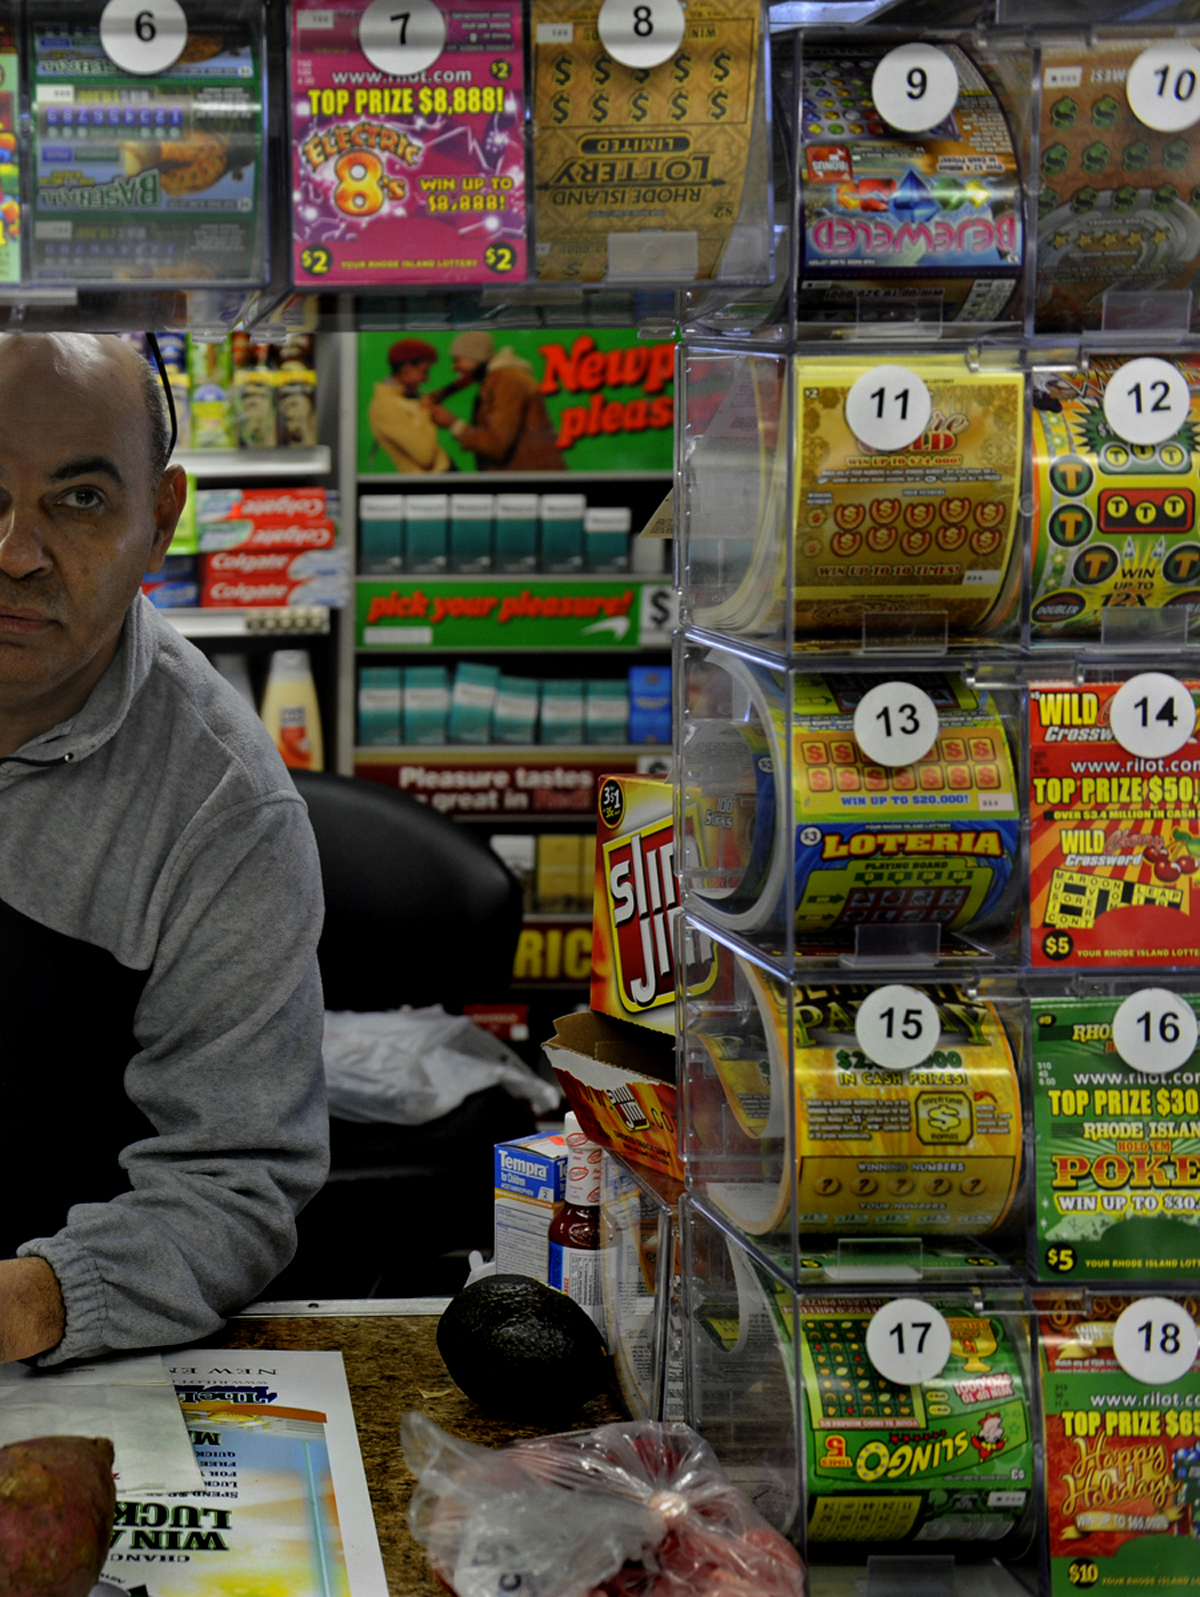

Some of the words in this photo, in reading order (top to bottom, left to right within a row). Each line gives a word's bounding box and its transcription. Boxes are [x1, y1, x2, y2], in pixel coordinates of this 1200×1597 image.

[134, 11, 157, 42] 6
[390, 13, 411, 45] 7
[632, 6, 654, 37] 8
[491, 61, 510, 78] $2
[906, 67, 928, 100] 9
[1153, 64, 1196, 101] 10
[308, 88, 350, 115] TOP
[354, 88, 414, 115] PRIZE
[418, 86, 505, 116] $8,888!
[301, 120, 423, 173] ELECTRIC
[596, 137, 675, 153] LIMITED
[553, 155, 712, 185] LOTTERY
[39, 168, 158, 209] BASEBALL
[420, 177, 456, 191] WIN
[462, 177, 485, 191] UP
[490, 177, 513, 191] TO
[631, 188, 702, 204] RHODE
[429, 194, 506, 213] $8,888!
[552, 189, 628, 206] ISLAND
[811, 214, 1017, 254] BEJEWELED
[301, 247, 328, 274] $2
[485, 247, 513, 271] $2
[870, 387, 911, 420] 11
[1127, 380, 1172, 414] 12
[240, 495, 325, 518] Colgate
[250, 524, 333, 547] Colgate
[210, 551, 290, 574] Colgate
[819, 566, 845, 577] WIN
[849, 565, 870, 576] UP
[873, 565, 891, 576] TO
[914, 565, 961, 575] TIMES!
[1121, 567, 1156, 579] WIN
[209, 580, 290, 603] Colgate
[367, 590, 429, 625] pick
[430, 594, 498, 625] your
[498, 589, 634, 624] pleasure!
[876, 703, 921, 737] 13
[1039, 692, 1099, 727] WILD
[1134, 696, 1179, 727] 14
[399, 765, 510, 790] Pleasure
[514, 766, 593, 790] tastes
[841, 796, 867, 806] WIN
[870, 796, 888, 806] UP
[891, 795, 908, 805] TO
[912, 794, 970, 805] $20,000!
[1032, 777, 1077, 804] TOP
[1081, 776, 1143, 803] PRIZE
[431, 791, 500, 815] great
[508, 791, 529, 809] in
[1053, 811, 1082, 820] OVER
[1083, 811, 1107, 820] $3.4
[1109, 811, 1151, 820] MILLION
[1153, 810, 1165, 819] IN
[1166, 810, 1196, 819] CASH
[821, 830, 1004, 860] LOTERIA
[1060, 829, 1106, 855] WILD
[865, 862, 910, 870] PLAYING
[912, 861, 948, 870] BOARD
[1064, 853, 1144, 867] Crossword
[1045, 937, 1070, 955] $5
[1076, 949, 1102, 958] YOUR
[1103, 949, 1135, 958] RHODE
[1136, 949, 1170, 957] ISLAND
[879, 1007, 924, 1040] 15
[1136, 1010, 1181, 1043] 16
[839, 1073, 857, 1086] IN
[862, 1072, 903, 1086] CASH
[909, 1072, 968, 1085] PRIZES!
[1048, 1089, 1090, 1116] TOP
[1094, 1088, 1153, 1116] PRIZE
[1082, 1122, 1144, 1142] RHODE
[1116, 1141, 1148, 1153] HOLD
[497, 1150, 549, 1179] Tempra
[857, 1163, 909, 1173] WINNING
[911, 1162, 966, 1173] NUMBERS
[542, 1190, 549, 1199] 2
[860, 1202, 891, 1210] YOUR
[1057, 1195, 1097, 1212] WIN
[1101, 1195, 1128, 1211] UP
[1131, 1194, 1159, 1211] TO
[1047, 1247, 1075, 1271] $5
[1085, 1259, 1110, 1269] YOUR
[1112, 1259, 1144, 1269] RHODE
[1145, 1259, 1178, 1268] ISLAND
[889, 1322, 933, 1353] 17
[1138, 1320, 1181, 1353] 18
[208, 1367, 278, 1375] NEW
[1062, 1411, 1102, 1437] TOP
[1105, 1410, 1162, 1437] PRIZE
[855, 1429, 970, 1482] SLINGO
[1072, 1431, 1168, 1480] Happy
[1060, 1468, 1182, 1517] Holidays
[129, 1529, 230, 1551] WIN
[1068, 1562, 1099, 1584] $10
